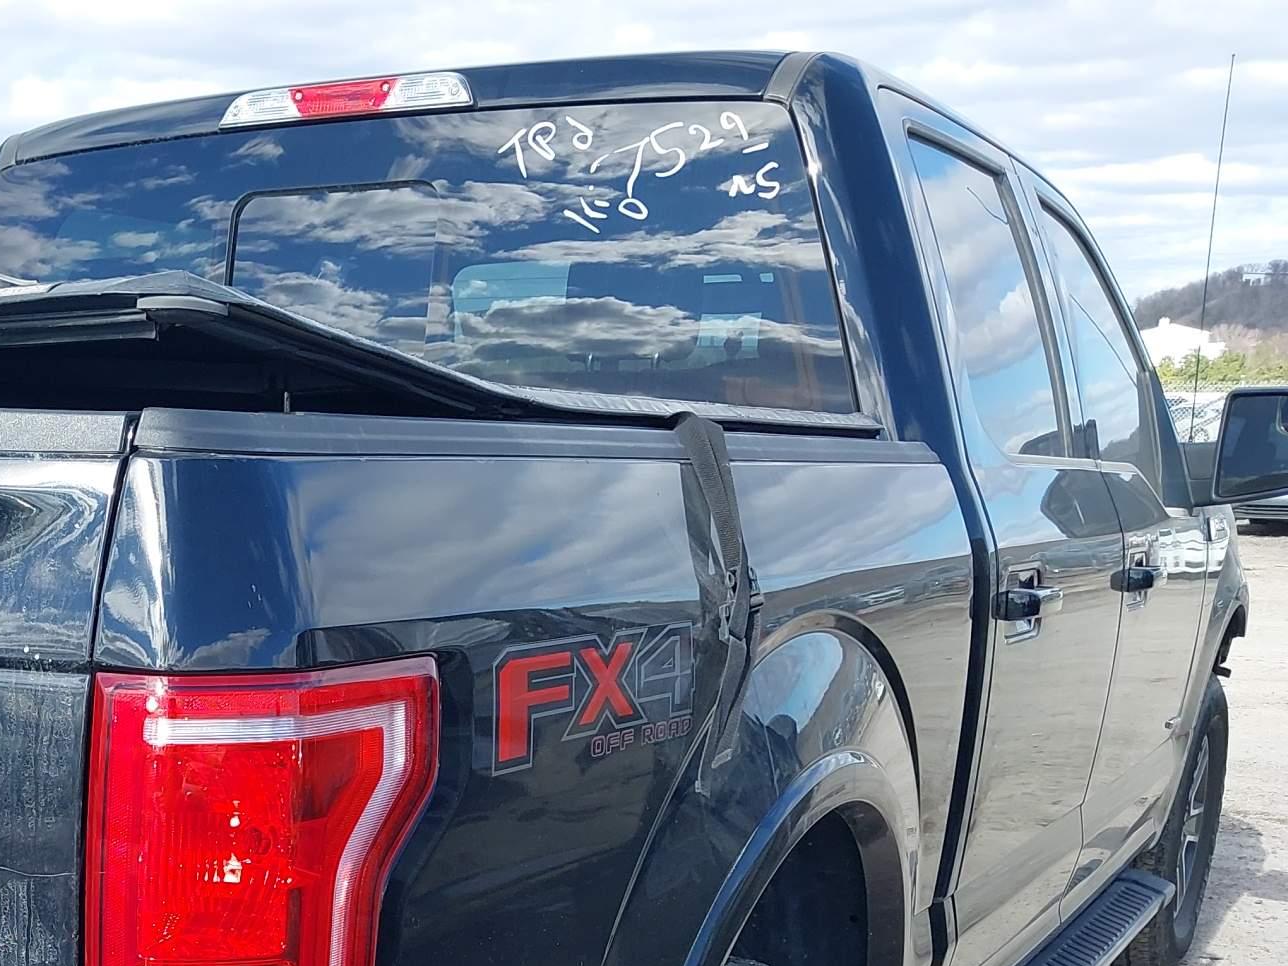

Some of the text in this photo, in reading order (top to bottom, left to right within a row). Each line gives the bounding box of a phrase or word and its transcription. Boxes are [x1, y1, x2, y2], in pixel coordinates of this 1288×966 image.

[492, 620, 696, 776] FX4
[591, 715, 692, 757] OFF ROAD
